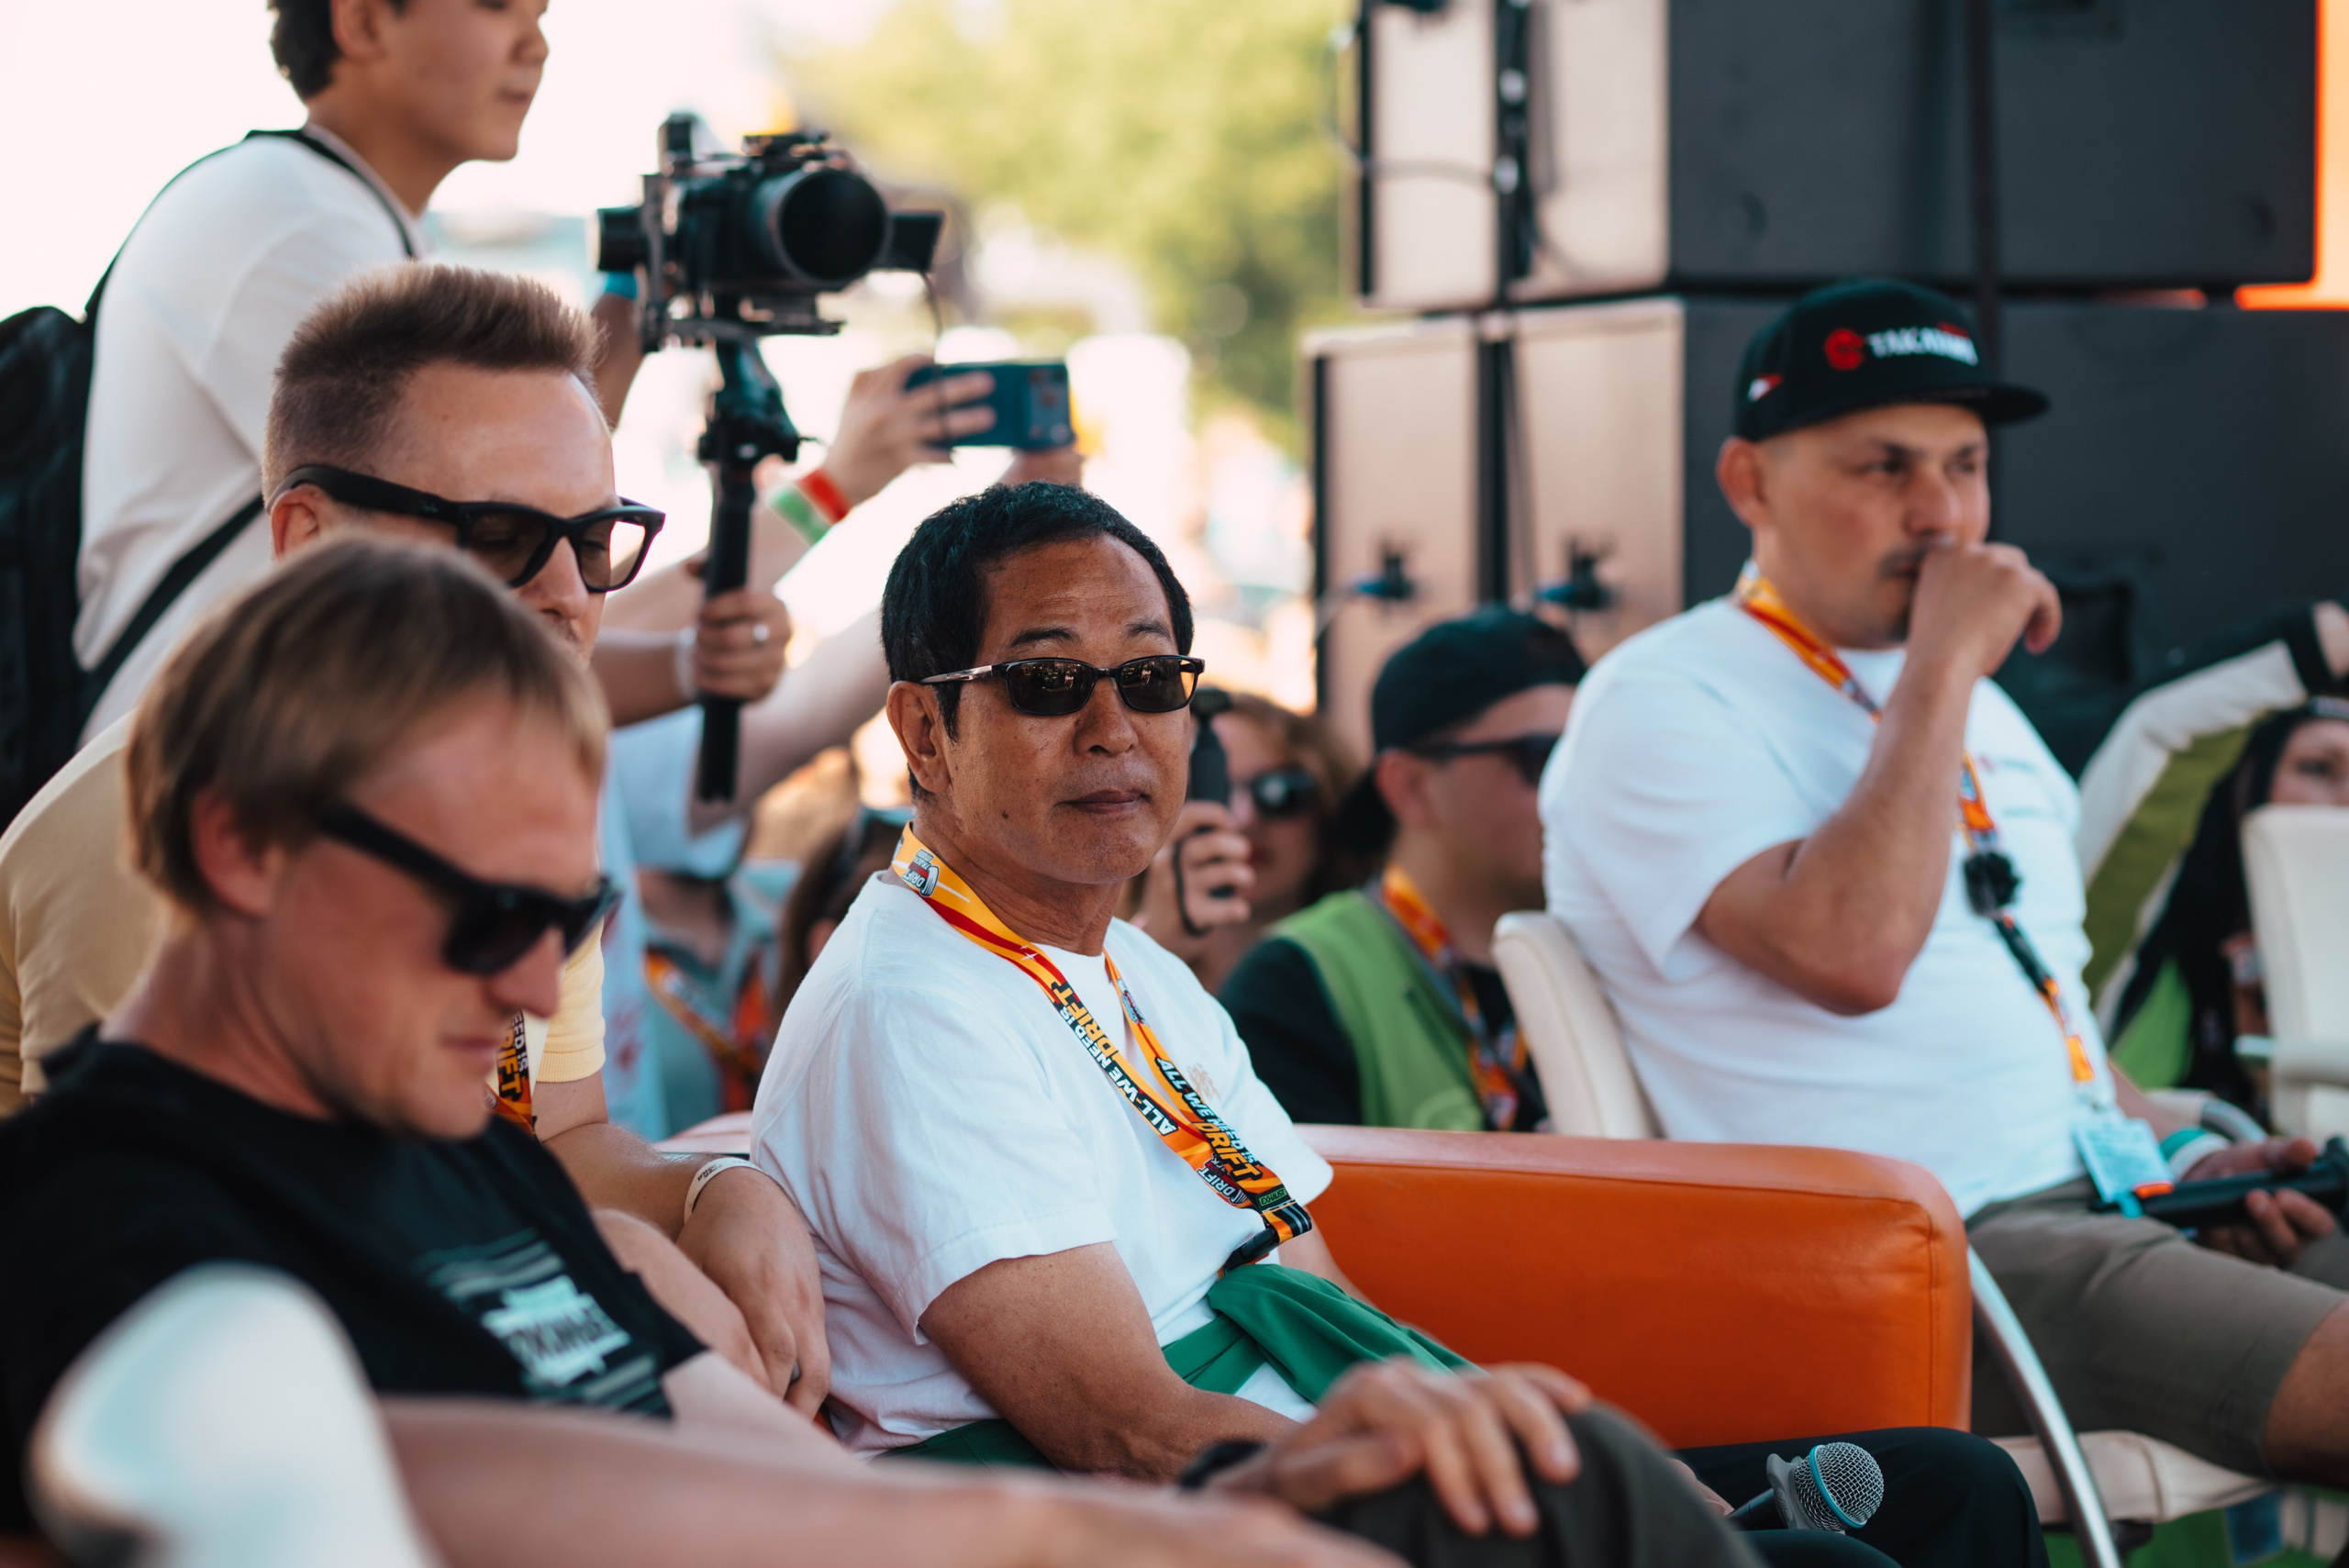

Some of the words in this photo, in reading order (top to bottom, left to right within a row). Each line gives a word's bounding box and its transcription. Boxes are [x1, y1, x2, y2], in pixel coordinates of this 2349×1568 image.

[903, 870, 925, 887] DRIFT
[513, 1013, 524, 1048] EED
[1052, 987, 1117, 1057] DRIFT
[1060, 1006, 1074, 1024] IS
[497, 1029, 521, 1092] RIFT
[1074, 1025, 1111, 1068] NEED
[1108, 1067, 1137, 1102] WE
[1139, 1099, 1176, 1135] ALL
[1156, 1058, 1186, 1089] ALL
[1186, 1090, 1214, 1118] WE
[1207, 1118, 1245, 1150] NEED
[1194, 1122, 1261, 1178] DRIFT
[1197, 1169, 1235, 1195] DRIFT
[1261, 1190, 1285, 1204] EXHAUST
